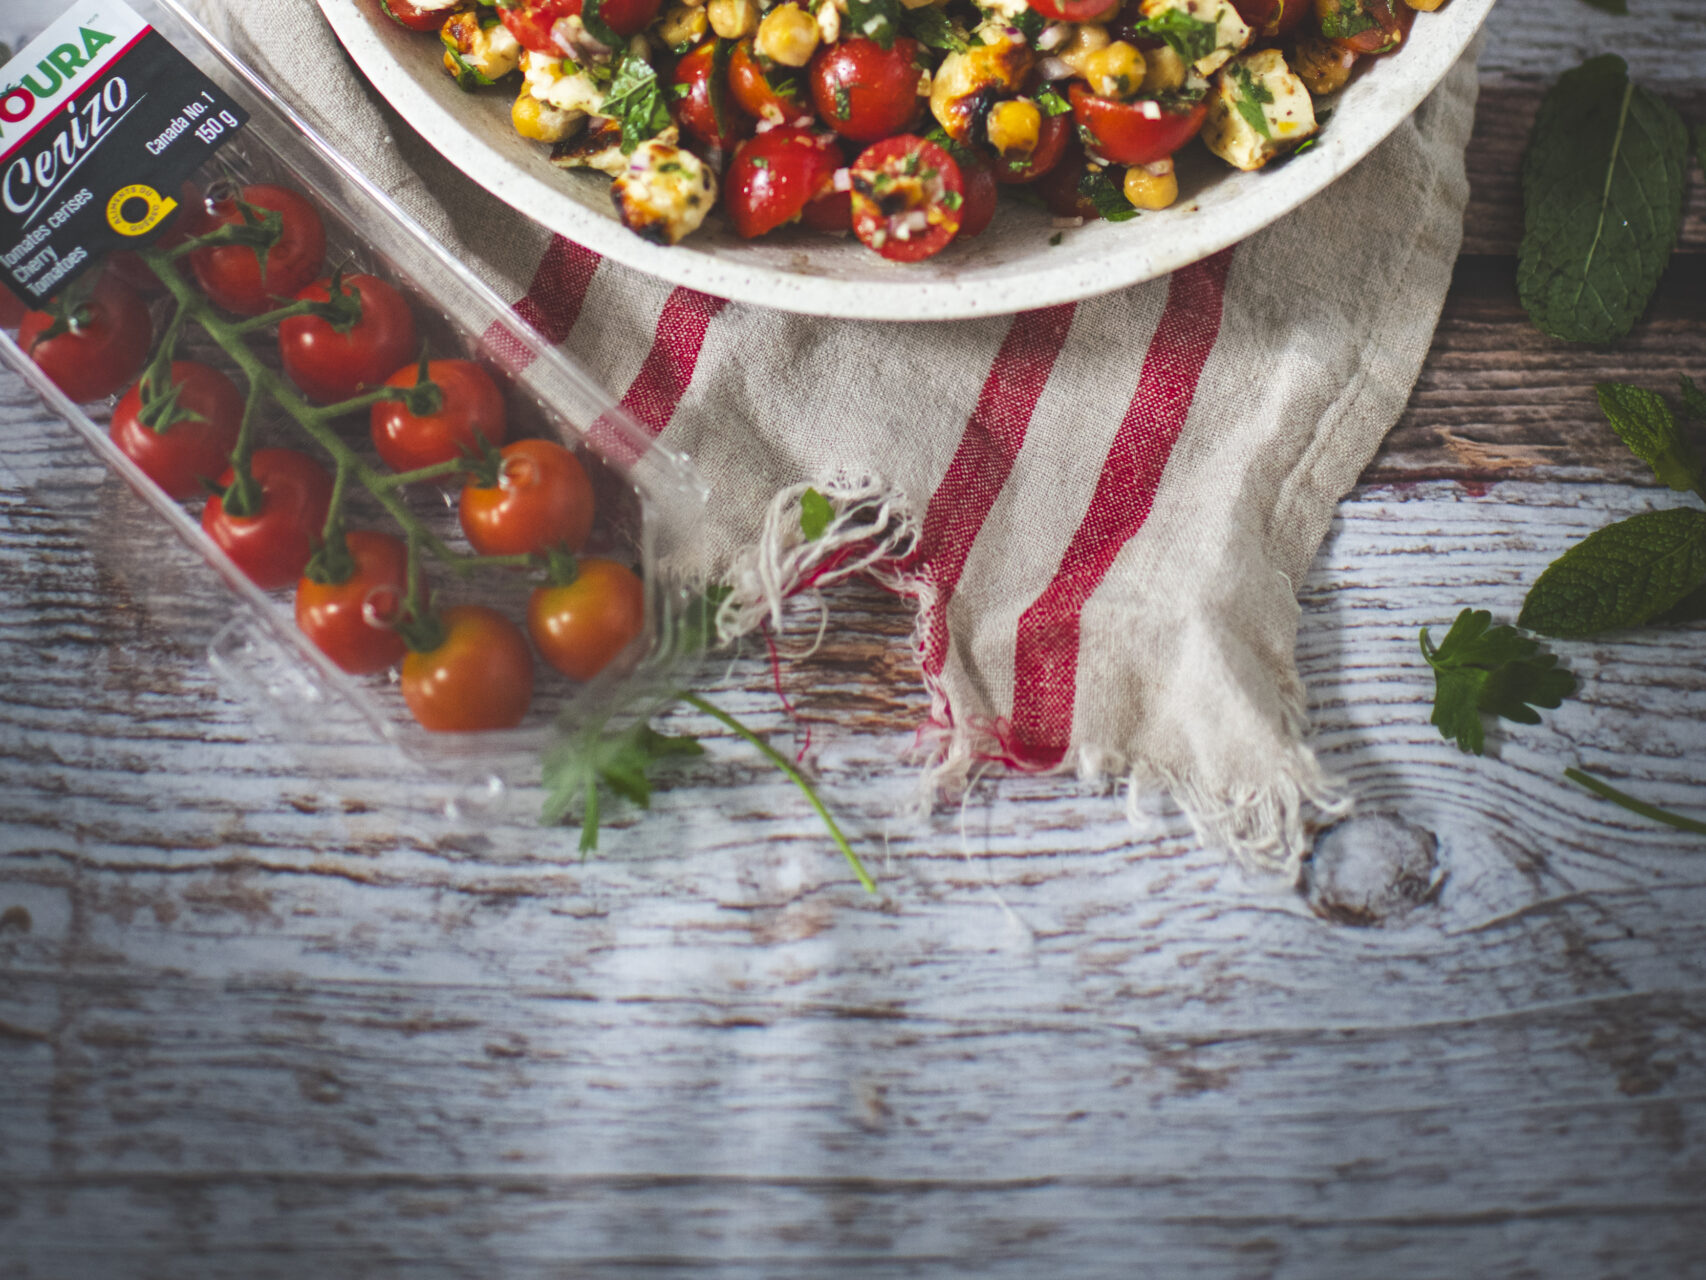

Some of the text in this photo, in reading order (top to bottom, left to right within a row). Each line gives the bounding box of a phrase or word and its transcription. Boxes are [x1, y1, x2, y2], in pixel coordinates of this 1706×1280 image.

[0, 27, 116, 138] OURA
[2, 76, 128, 214] Cerizo
[145, 91, 215, 155] Canada No. 1
[194, 110, 239, 144] 150 g
[0, 188, 93, 269] Tomates cerises
[12, 245, 58, 283] Cherry
[26, 246, 88, 296] Tomatoes
